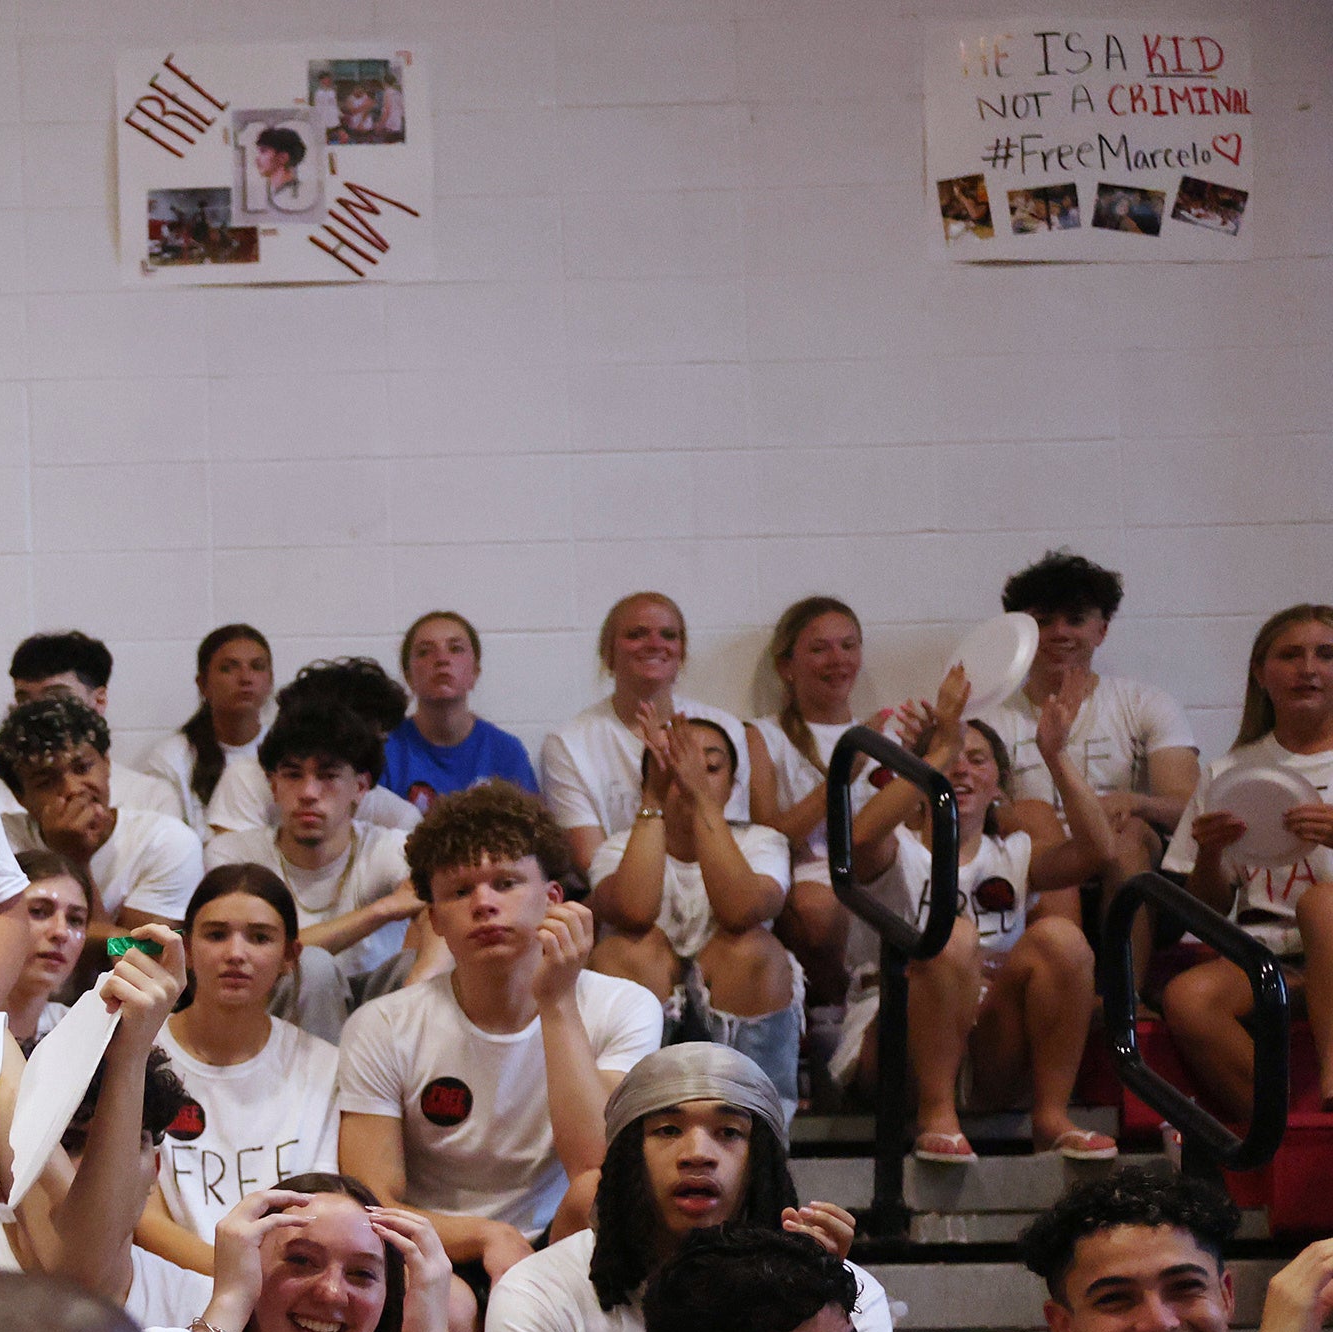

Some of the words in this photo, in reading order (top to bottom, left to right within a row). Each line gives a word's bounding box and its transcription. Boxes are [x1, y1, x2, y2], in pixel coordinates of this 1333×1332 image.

[959, 34, 1013, 78] HE
[1034, 32, 1093, 75] IS
[1105, 34, 1127, 71] A
[1143, 34, 1225, 74] KID
[125, 52, 230, 159] FREE
[976, 91, 1052, 120] NOT
[1071, 85, 1094, 113] A
[981, 134, 1212, 175] #FreeMarcelo
[308, 182, 420, 277] HIM
[171, 1138, 299, 1205] FREE
